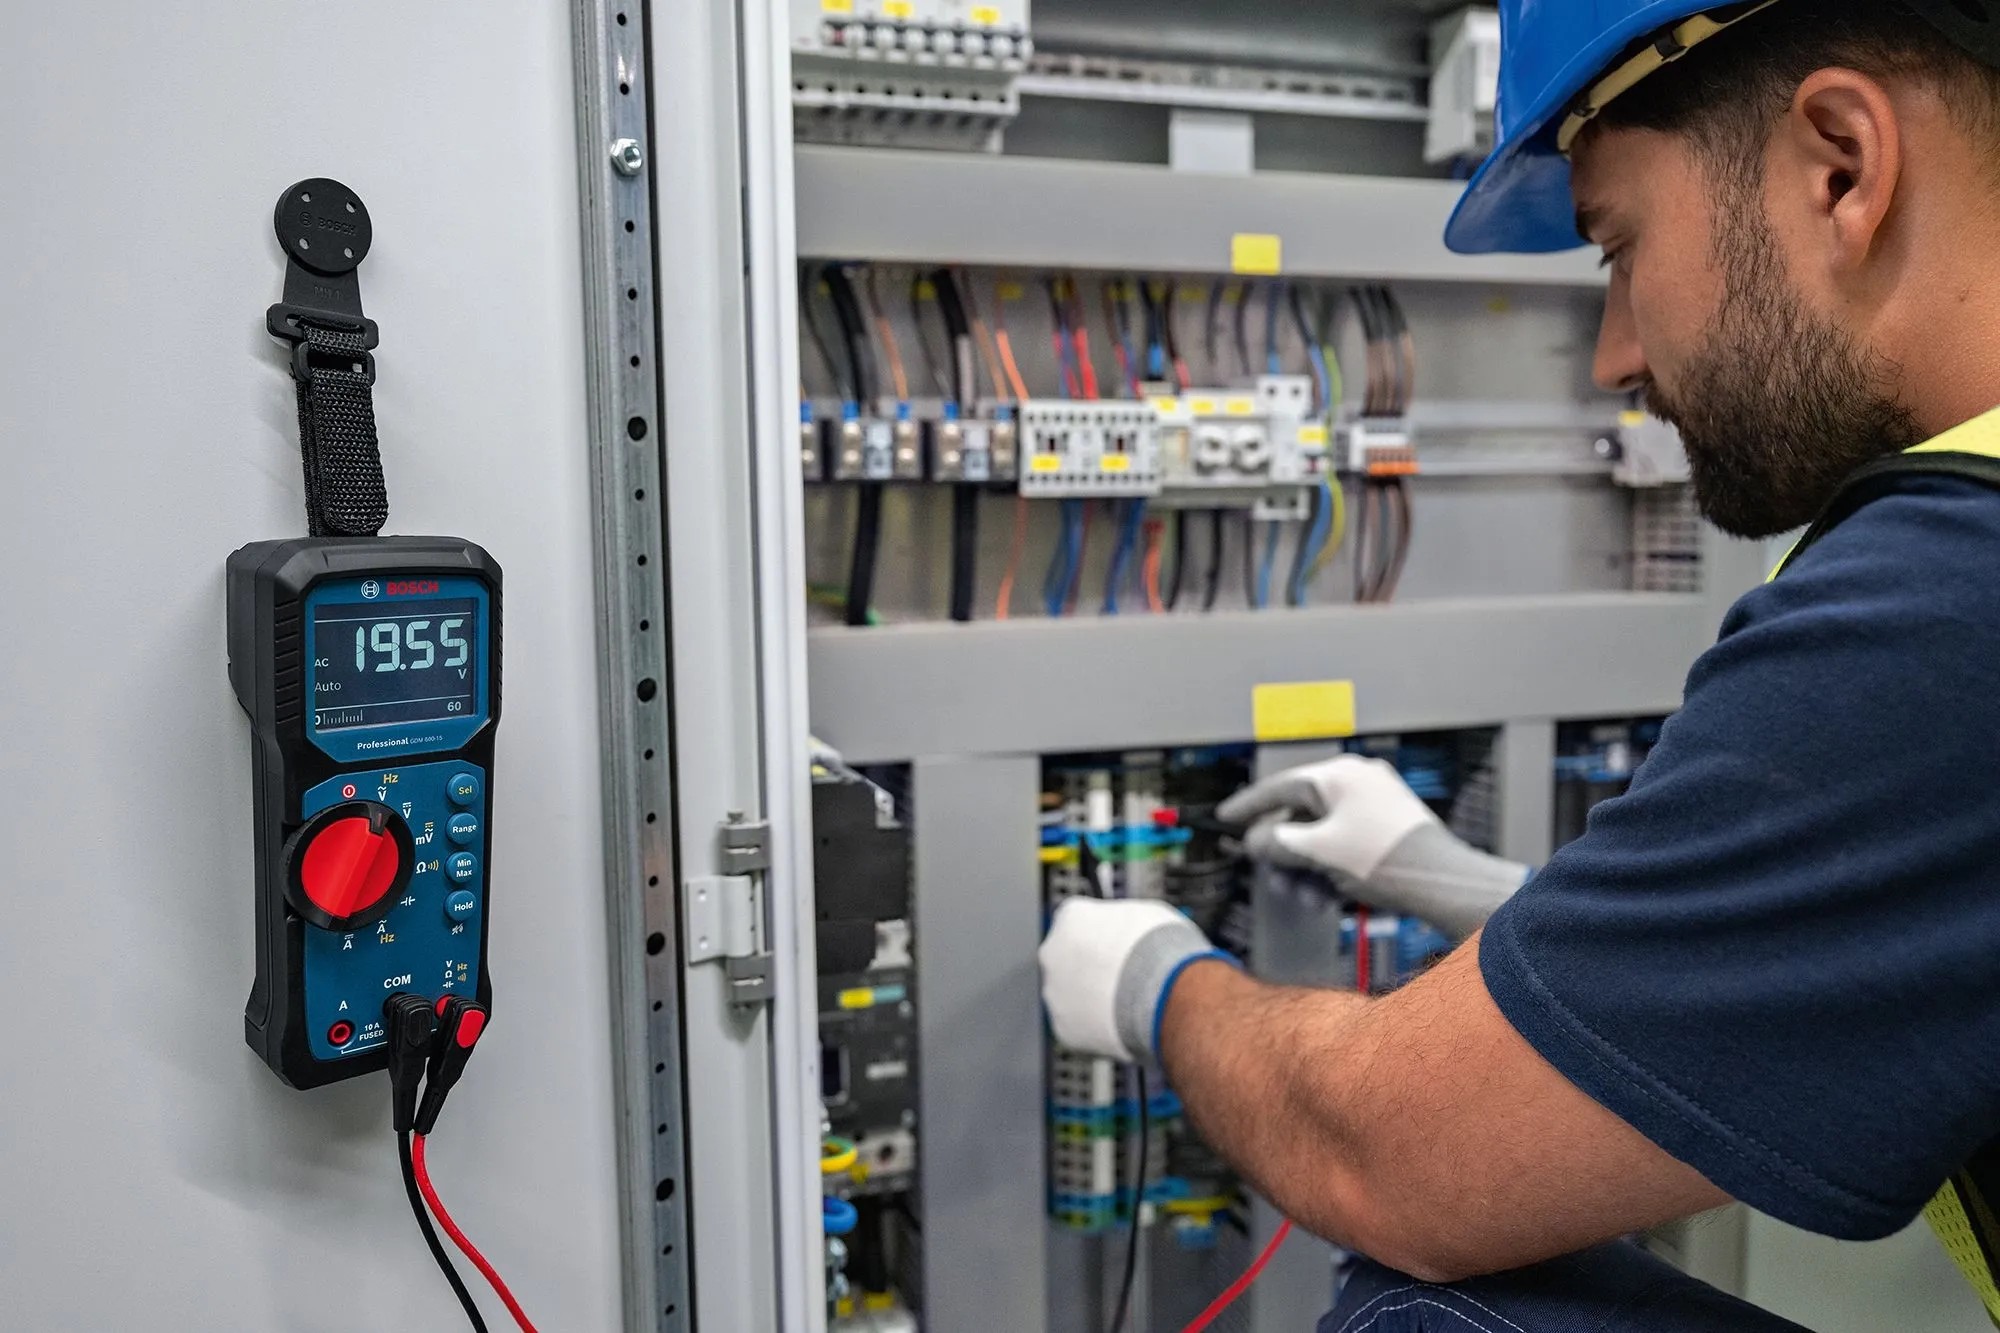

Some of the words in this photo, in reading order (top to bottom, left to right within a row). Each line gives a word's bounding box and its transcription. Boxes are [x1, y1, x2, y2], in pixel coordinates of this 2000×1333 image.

[387, 581, 438, 594] BOSCH
[356, 619, 468, 672] 19.55
[315, 658, 329, 667] AC
[458, 669, 467, 679] V
[315, 682, 341, 692] Auto
[447, 702, 462, 712] 60
[357, 737, 409, 750] Professional
[383, 774, 398, 784] Hz
[458, 786, 472, 795] Sel
[452, 824, 477, 834] Range
[457, 859, 472, 868] Min
[456, 869, 472, 878] Max
[454, 901, 473, 912] Hold
[380, 934, 395, 944] Hz
[457, 963, 468, 971] Hz
[384, 975, 411, 988] COM
[339, 1001, 347, 1011] A
[359, 1029, 384, 1041] FUSED
